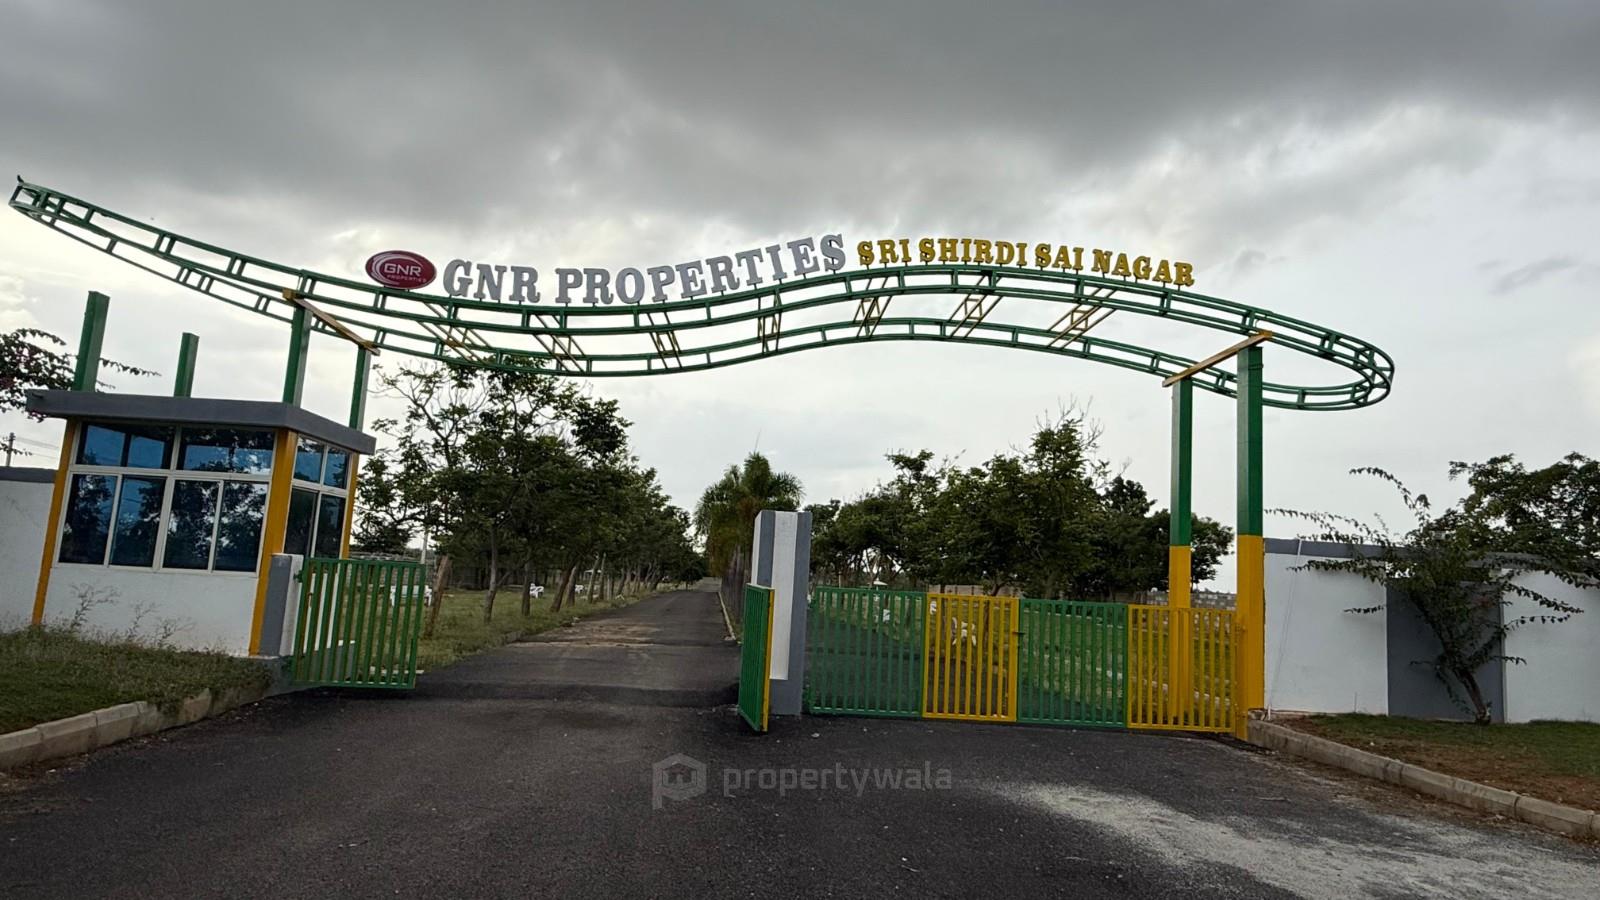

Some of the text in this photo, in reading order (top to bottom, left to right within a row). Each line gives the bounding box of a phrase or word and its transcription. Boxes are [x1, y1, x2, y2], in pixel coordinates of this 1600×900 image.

[384, 263, 421, 276] GNR
[443, 233, 846, 304] GNR PROPERTIES
[857, 238, 1195, 286] SRI SHIRDI SAI NAGAR
